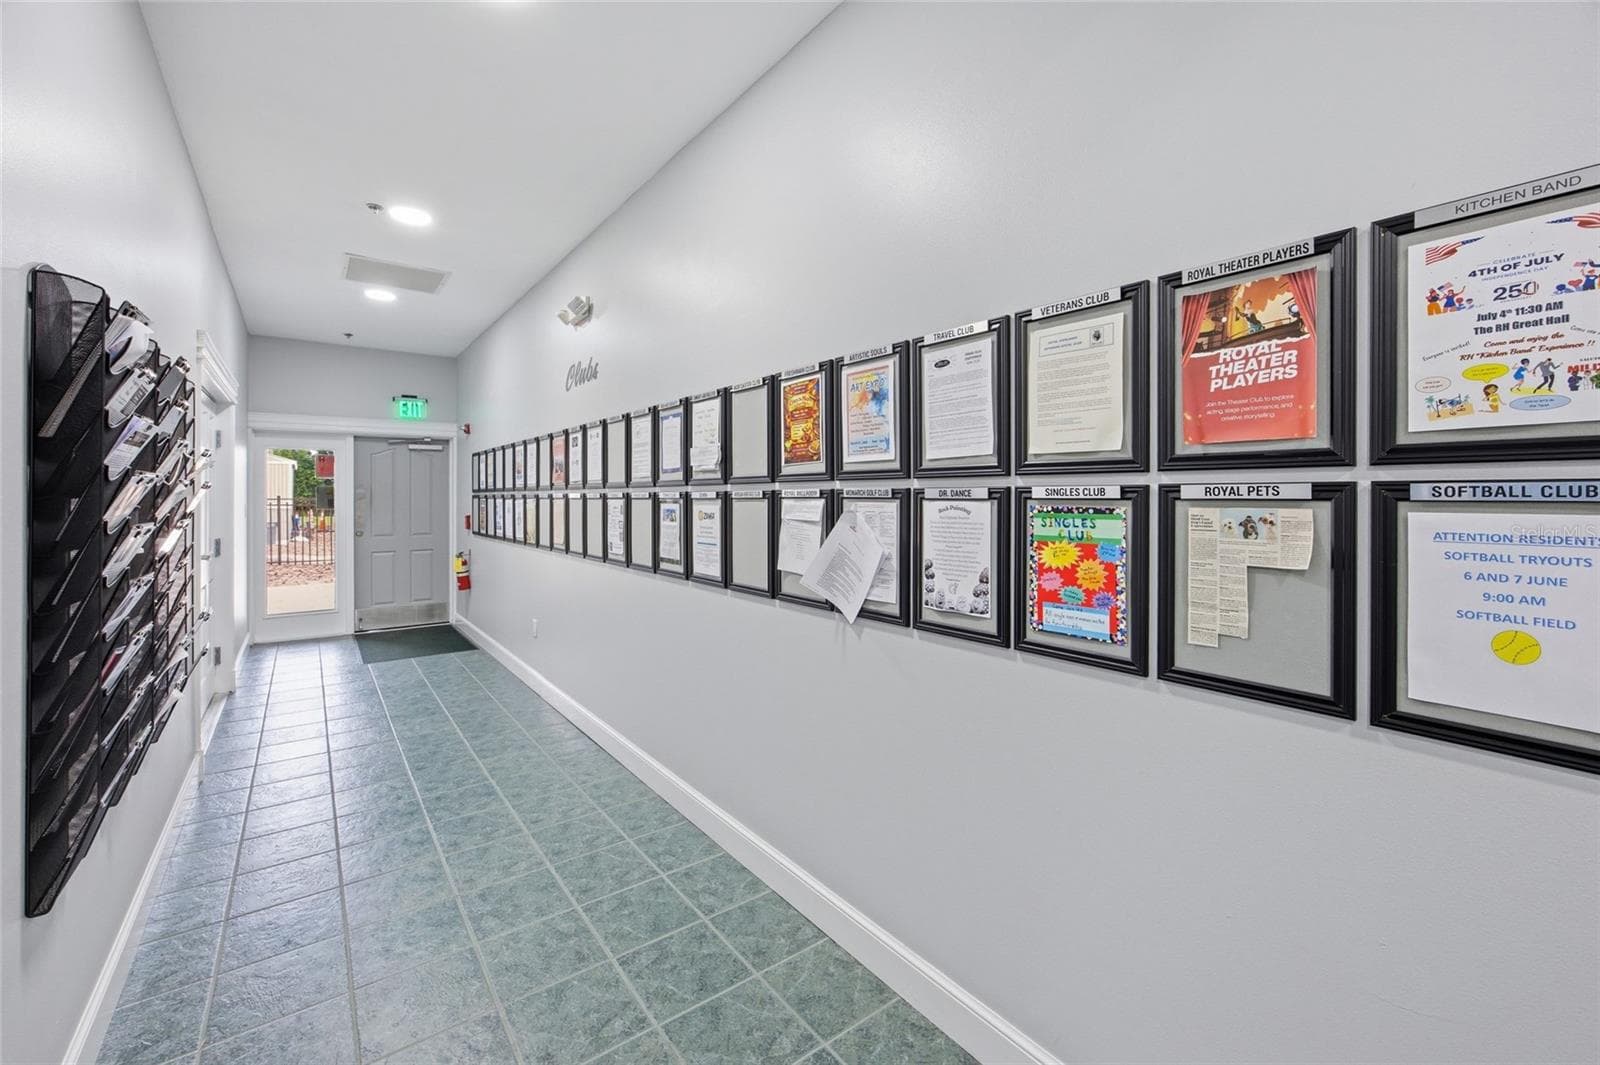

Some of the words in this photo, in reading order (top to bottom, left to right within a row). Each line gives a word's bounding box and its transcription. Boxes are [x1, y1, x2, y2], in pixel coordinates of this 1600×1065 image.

[1454, 189, 1527, 215] KITCHEN
[1531, 174, 1582, 197] BAND
[1187, 266, 1216, 282] ROYAL
[1218, 255, 1260, 275] THEATER
[1262, 242, 1310, 263] PLAYERS
[1468, 266, 1498, 279] 4TH
[1500, 261, 1522, 272] OF
[1524, 252, 1565, 267] JULY
[1040, 298, 1083, 316] VETERANS
[1085, 291, 1110, 306] CLUB
[1476, 312, 1498, 323] July
[1515, 303, 1543, 316] 11:30
[1545, 300, 1564, 312] AM
[933, 330, 955, 341] TRAVEL
[957, 325, 974, 336] CLUB
[1473, 325, 1493, 336] The
[1495, 321, 1510, 333] RH
[1512, 317, 1544, 331] Great
[1546, 313, 1570, 326] Hall
[1219, 340, 1282, 364] ROYAL
[565, 356, 600, 393] Clubs
[1208, 349, 1298, 379] THEATER
[1209, 364, 1298, 393] PLAYERS
[401, 400, 424, 418] EXIT
[938, 489, 950, 498] DR.
[950, 489, 972, 498] DANCE
[1044, 488, 1081, 497] SINGLES
[1082, 488, 1106, 497] CLUB
[1204, 486, 1244, 497] ROYAL
[1247, 486, 1280, 496] PETS
[1431, 485, 1532, 498] SOFTBALL
[1540, 484, 1599, 498] CLUB
[1432, 531, 1513, 543] ATTENTION
[1443, 551, 1515, 564] SOFTBALL
[1518, 554, 1593, 568] TRYOUTS
[1463, 571, 1473, 581] 6
[1475, 572, 1509, 583] AND
[1513, 574, 1523, 584] 7
[1526, 575, 1569, 588] JUNE
[1482, 592, 1515, 604] 9:00
[1518, 595, 1547, 606] AM
[1456, 609, 1529, 626] SOFTBALL
[1532, 616, 1577, 630] FIELD
